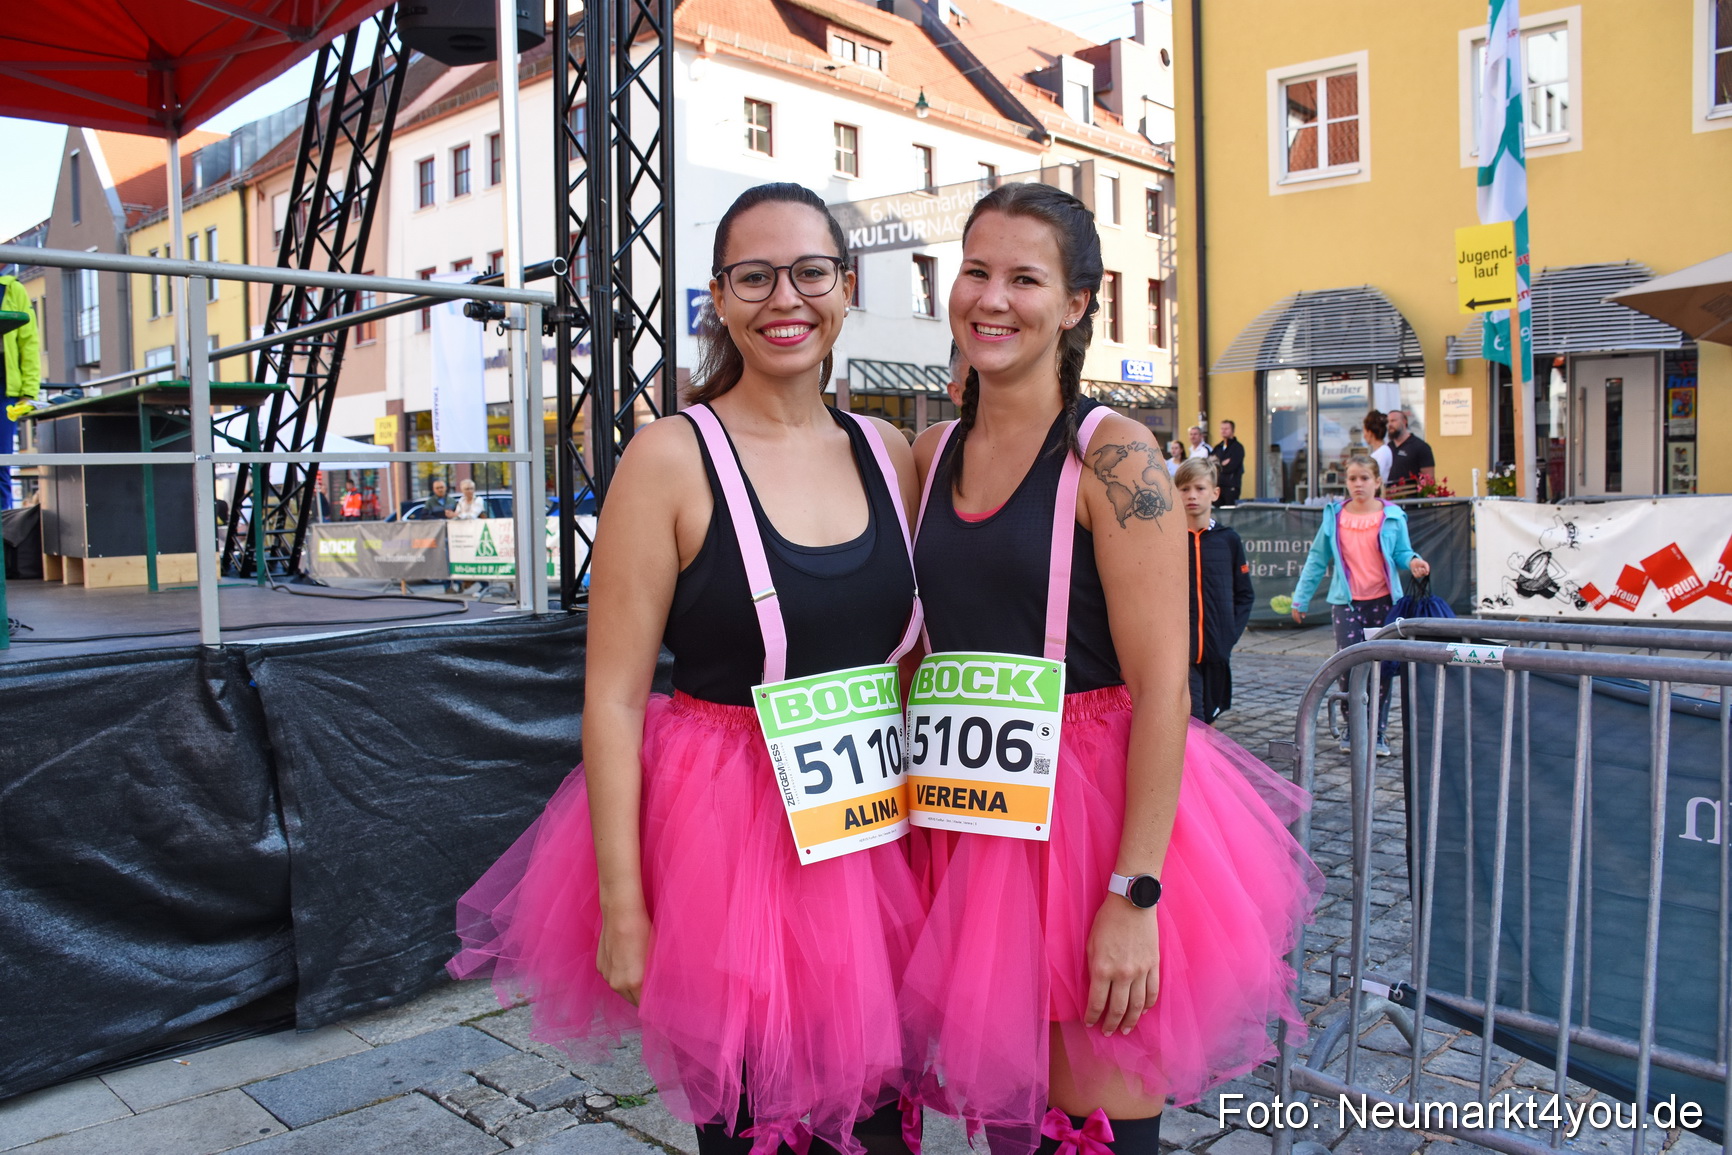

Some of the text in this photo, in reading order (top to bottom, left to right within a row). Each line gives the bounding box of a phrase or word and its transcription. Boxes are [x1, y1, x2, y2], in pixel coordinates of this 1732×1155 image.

[849, 211, 968, 249] KULTURNAC
[1458, 245, 1513, 265] Jugend-
[1473, 263, 1499, 278] lauf
[318, 539, 357, 555] BOCK
[1241, 540, 1312, 552] ommen
[1611, 585, 1639, 604] Braun
[1659, 575, 1699, 601] Braun
[915, 661, 1045, 704] BOCK
[771, 673, 898, 729] BOCK
[912, 715, 1035, 772] 5106
[1041, 727, 1050, 737] S
[794, 725, 900, 794] 5110
[916, 784, 1008, 813] VERENA
[844, 796, 899, 830] ALINA
